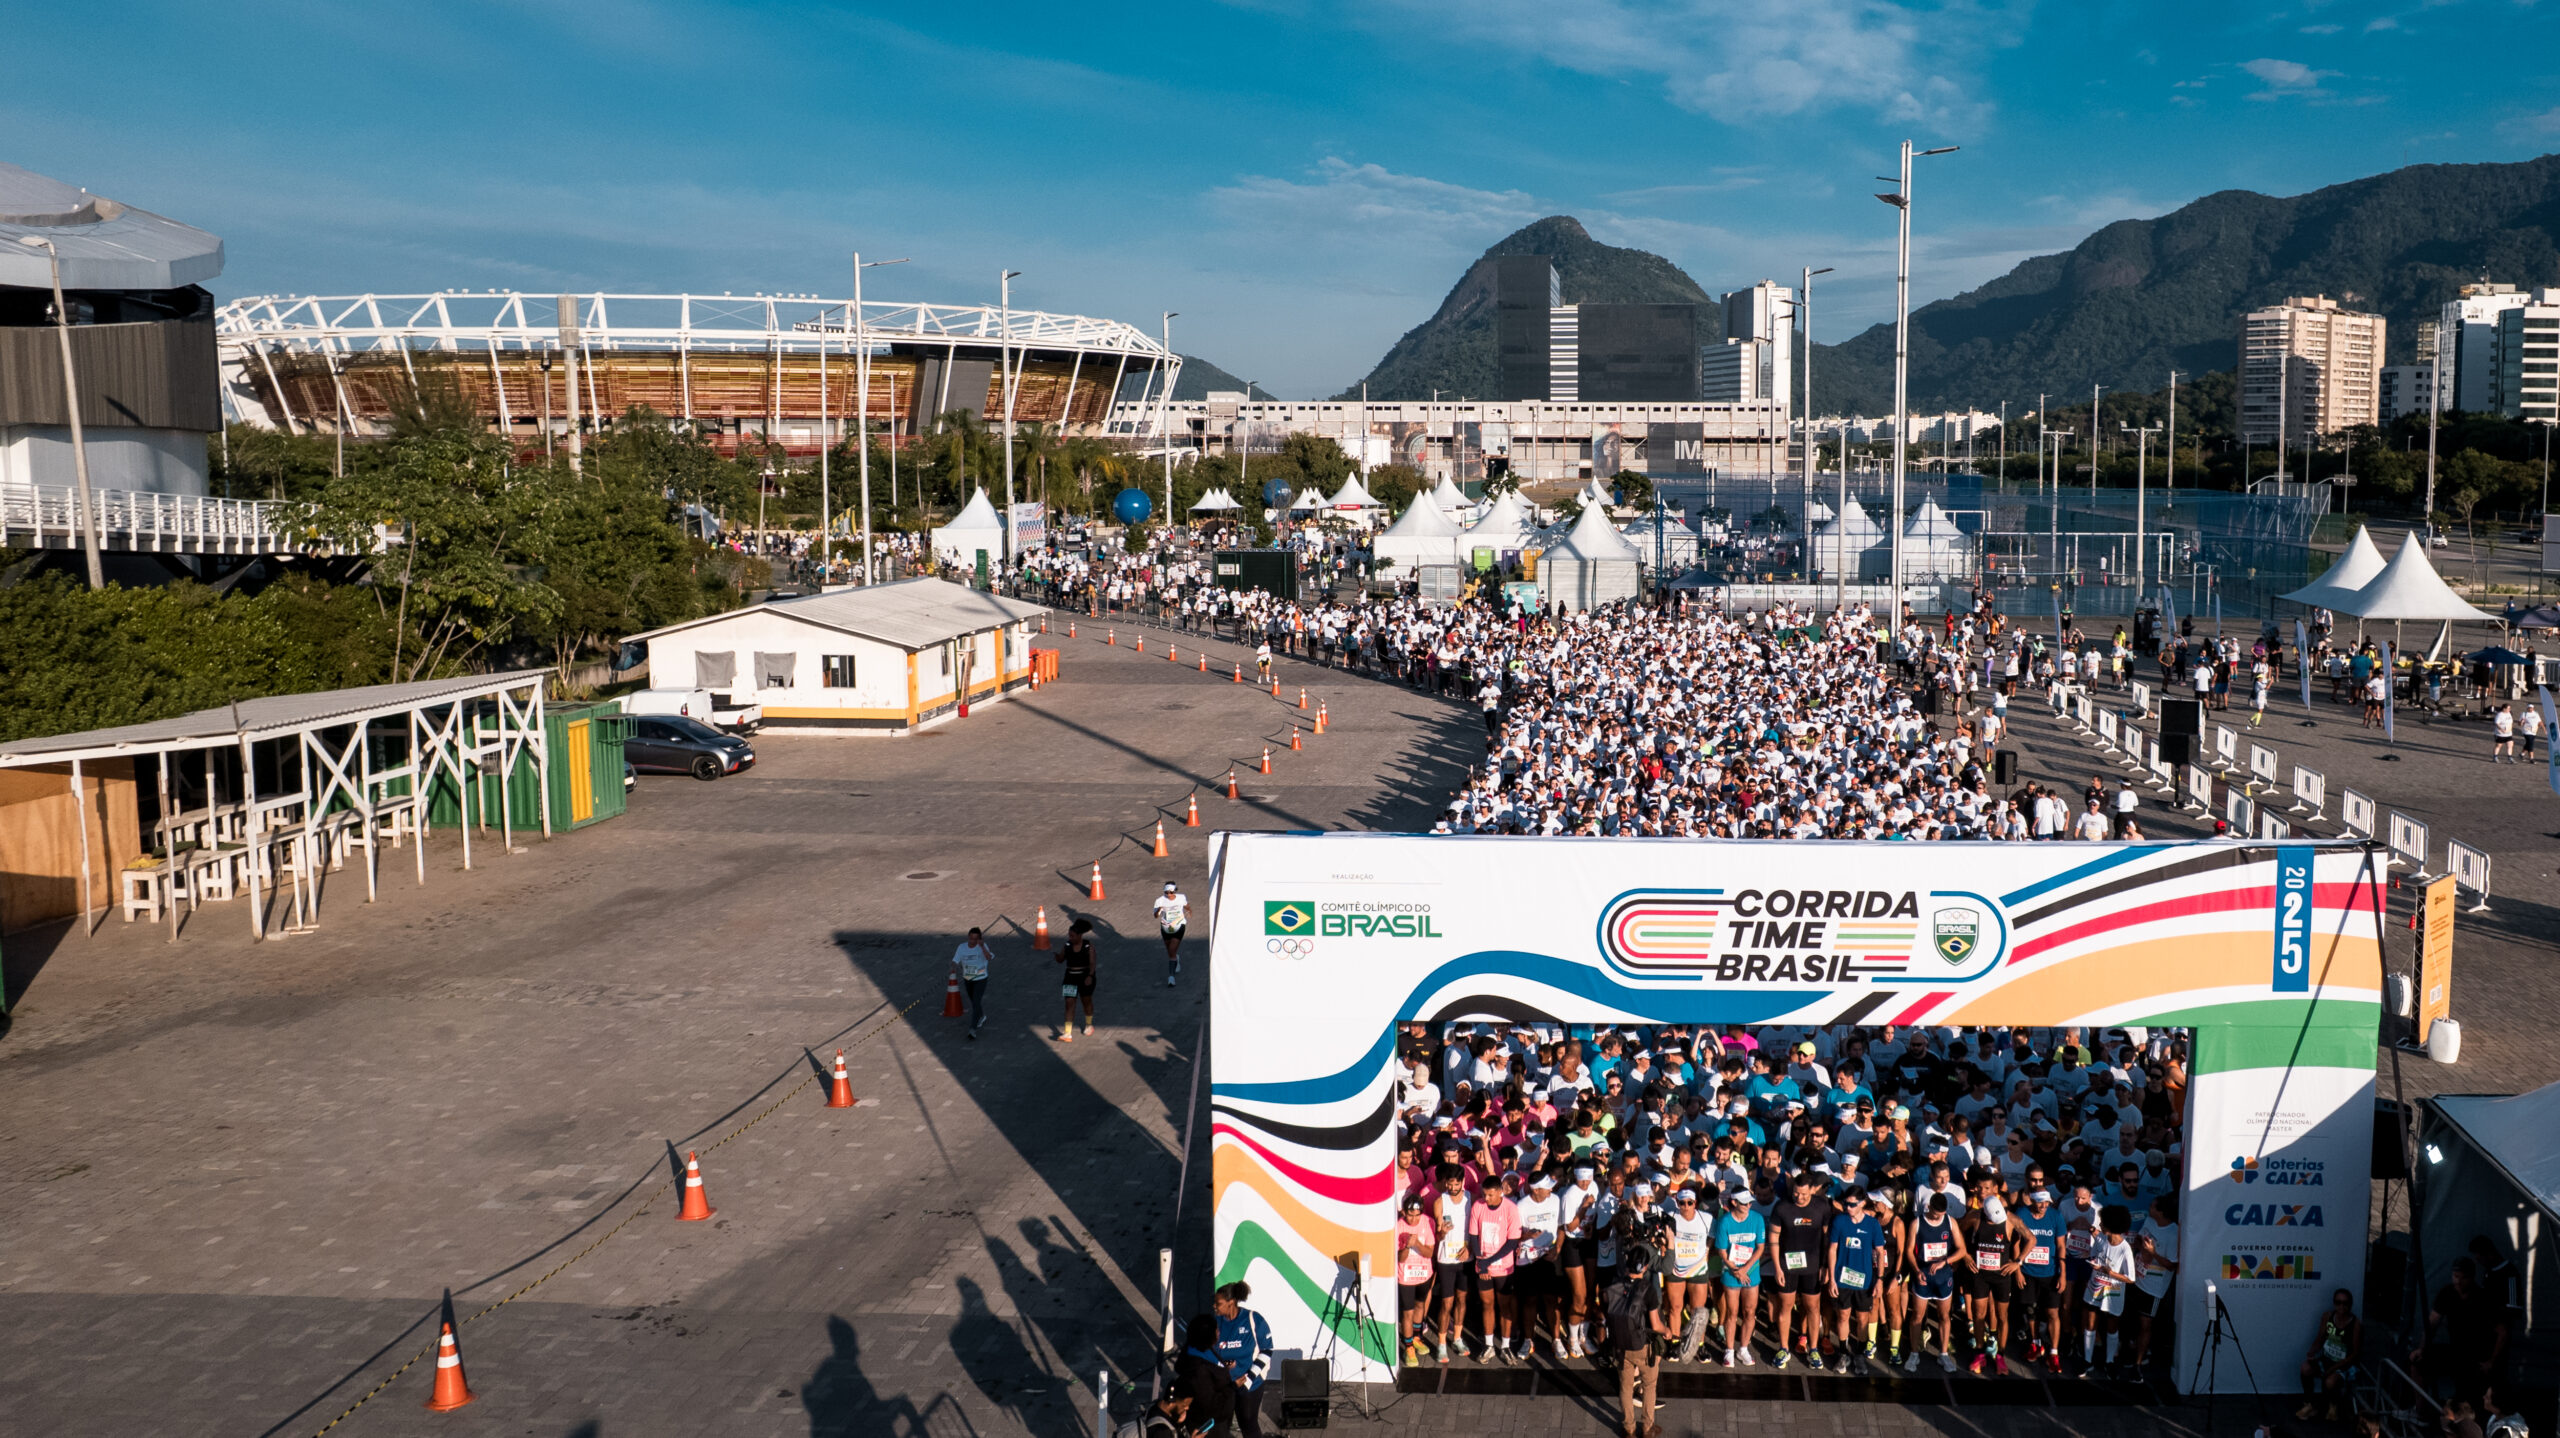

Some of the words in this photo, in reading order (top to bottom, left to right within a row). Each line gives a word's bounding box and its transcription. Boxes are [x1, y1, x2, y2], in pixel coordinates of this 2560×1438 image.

[1331, 873, 1374, 881] REALIZAÇÃO
[1321, 901, 1361, 912] COMITÊ
[1363, 901, 1413, 912] OLÍMPICO
[1415, 904, 1431, 912] DO
[1733, 889, 1920, 918] CORRIDA
[1321, 914, 1443, 938] BRASIL
[1937, 925, 1975, 934] BRASIL
[2281, 866, 2306, 974] 2025
[1728, 921, 1826, 948] TIME
[1715, 954, 1859, 982] BRASIL
[2266, 1157, 2324, 1171] loterias
[2265, 1172, 2324, 1186] CAIXA
[2224, 1203, 2324, 1227] CAIXA
[2221, 1255, 2322, 1280] BRASIL
